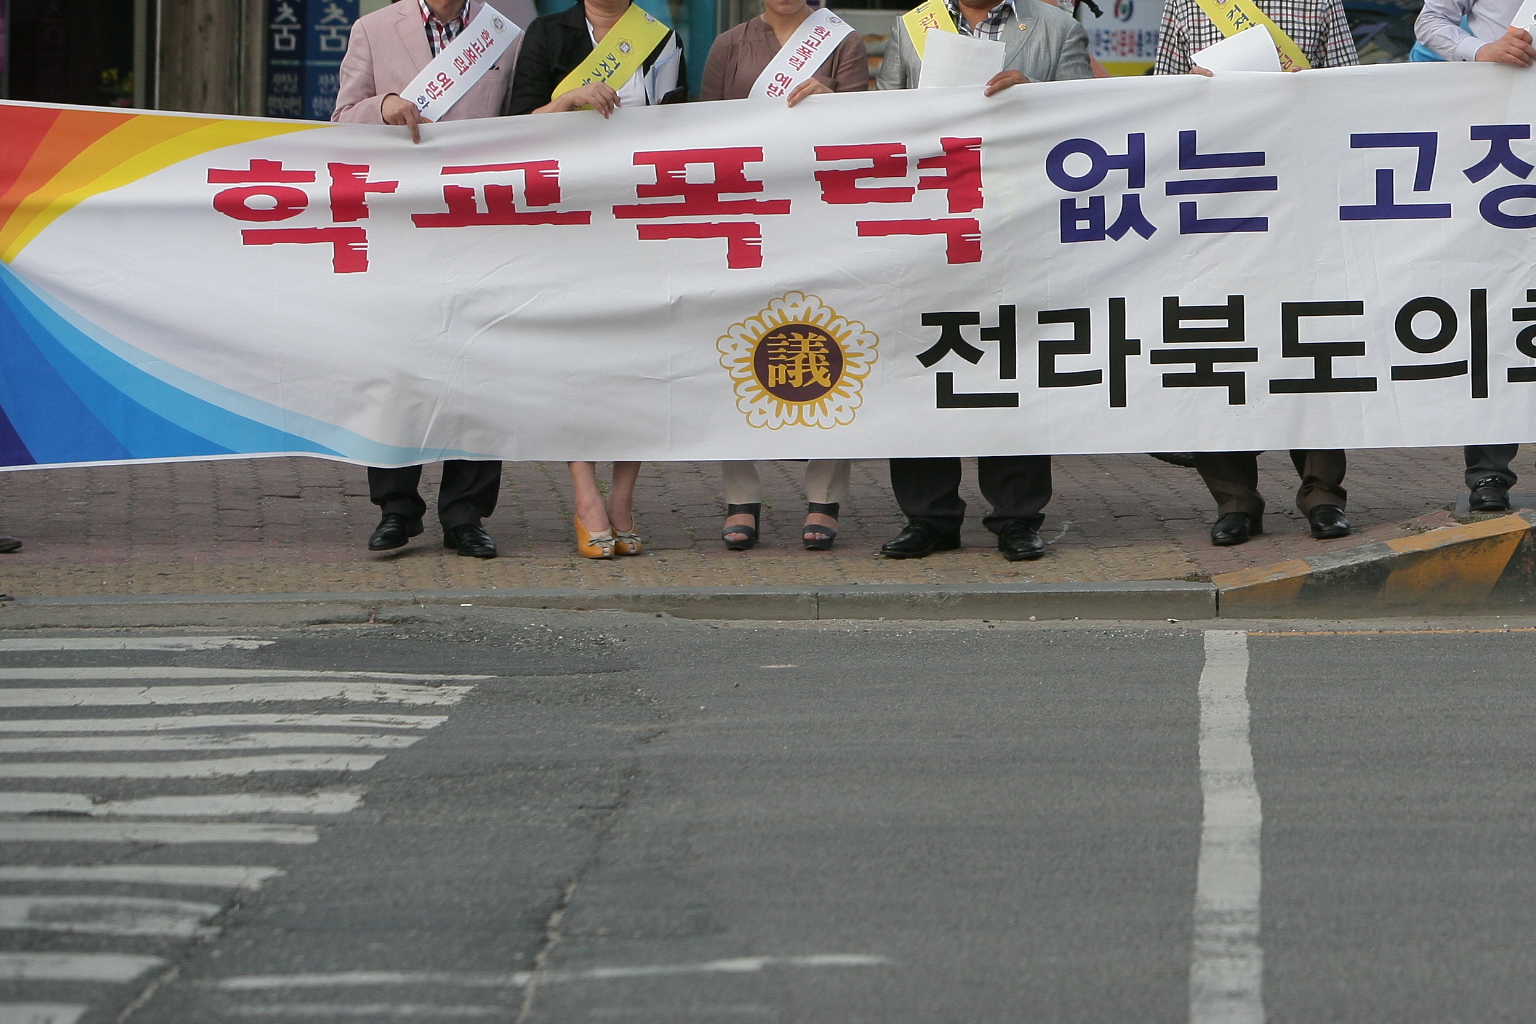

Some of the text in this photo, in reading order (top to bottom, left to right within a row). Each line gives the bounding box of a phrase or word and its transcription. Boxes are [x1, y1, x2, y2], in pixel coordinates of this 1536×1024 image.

[451, 27, 496, 78] 학교폭력
[787, 23, 833, 73] 학교폭력
[426, 70, 456, 102] 예방
[206, 136, 984, 274] 학교폭력
[1045, 130, 1279, 244] 없는
[766, 331, 832, 389] 議
